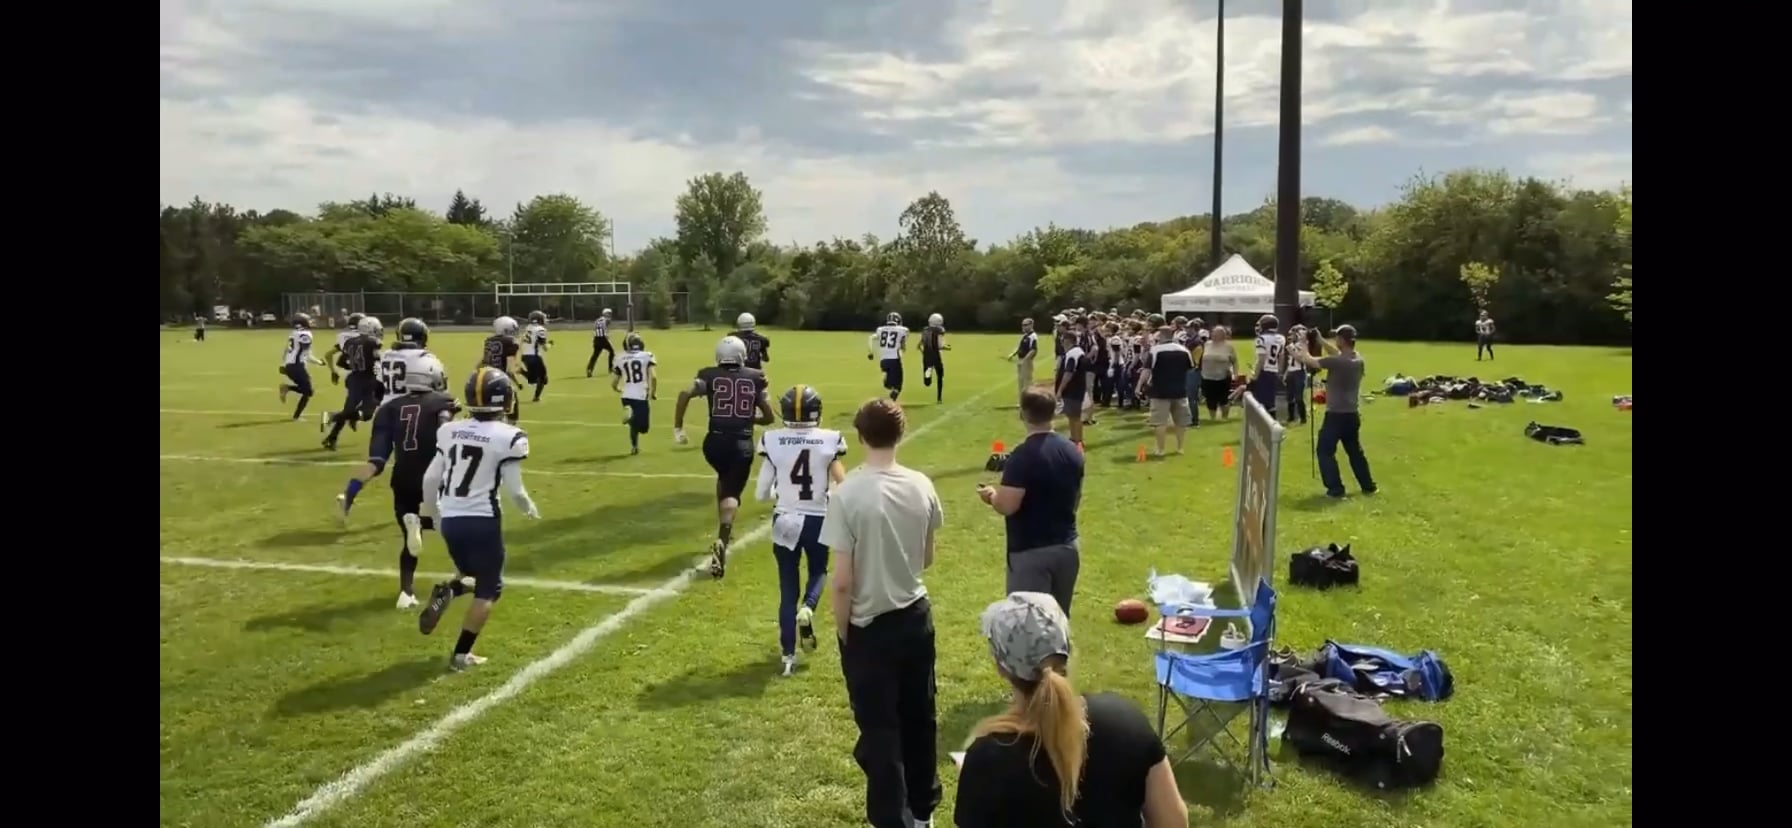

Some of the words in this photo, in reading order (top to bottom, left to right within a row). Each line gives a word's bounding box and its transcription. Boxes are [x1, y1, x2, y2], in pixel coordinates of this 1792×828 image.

[879, 331, 898, 349] 83
[623, 360, 643, 383] 18
[711, 377, 756, 418] 26
[400, 404, 421, 451] 7
[786, 438, 824, 446] FORTRESS
[444, 444, 484, 498] 17
[790, 448, 814, 501] 4
[1320, 732, 1351, 756] Reebok
